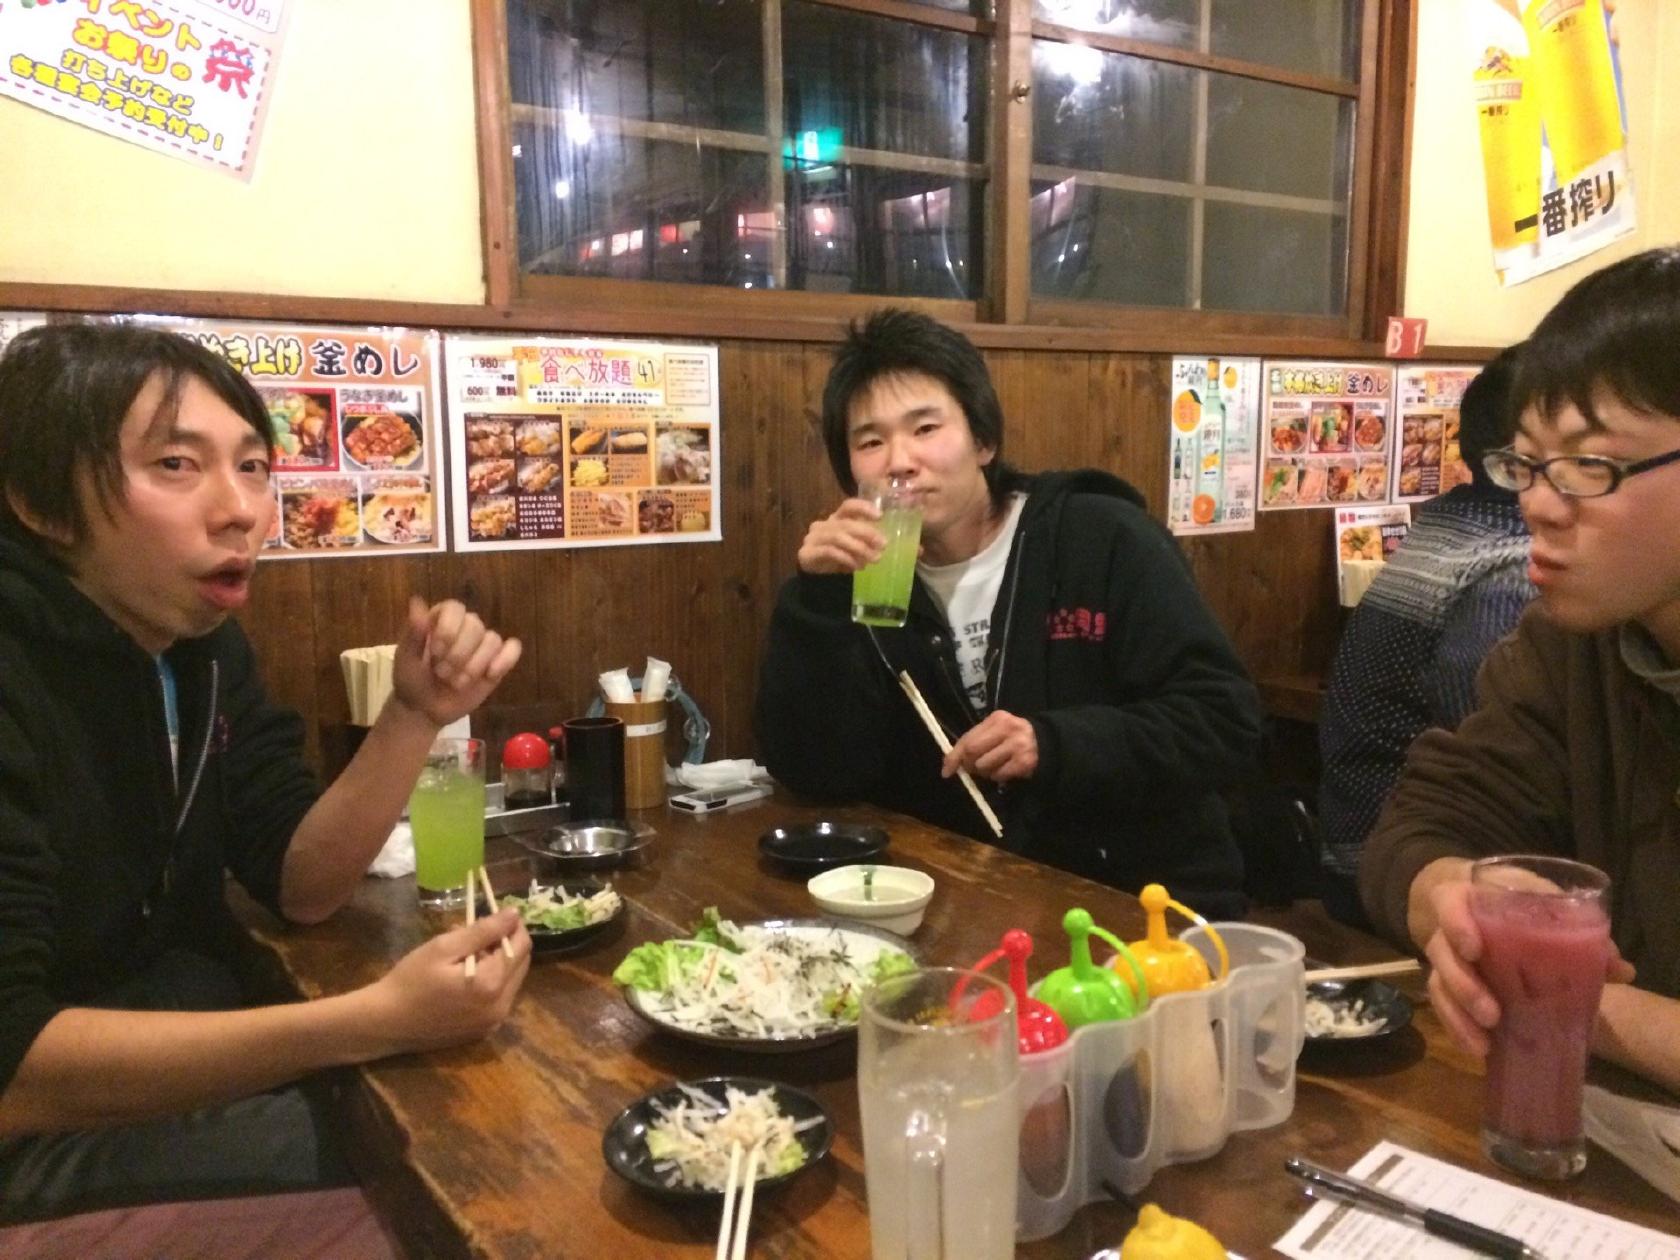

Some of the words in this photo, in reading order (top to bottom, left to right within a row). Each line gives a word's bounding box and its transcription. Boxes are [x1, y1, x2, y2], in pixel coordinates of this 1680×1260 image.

[1514, 170, 1616, 237] 一番搾り
[311, 340, 419, 376] 釜めし
[540, 357, 633, 386] 食べ放題
[1347, 372, 1388, 394] 釜めし
